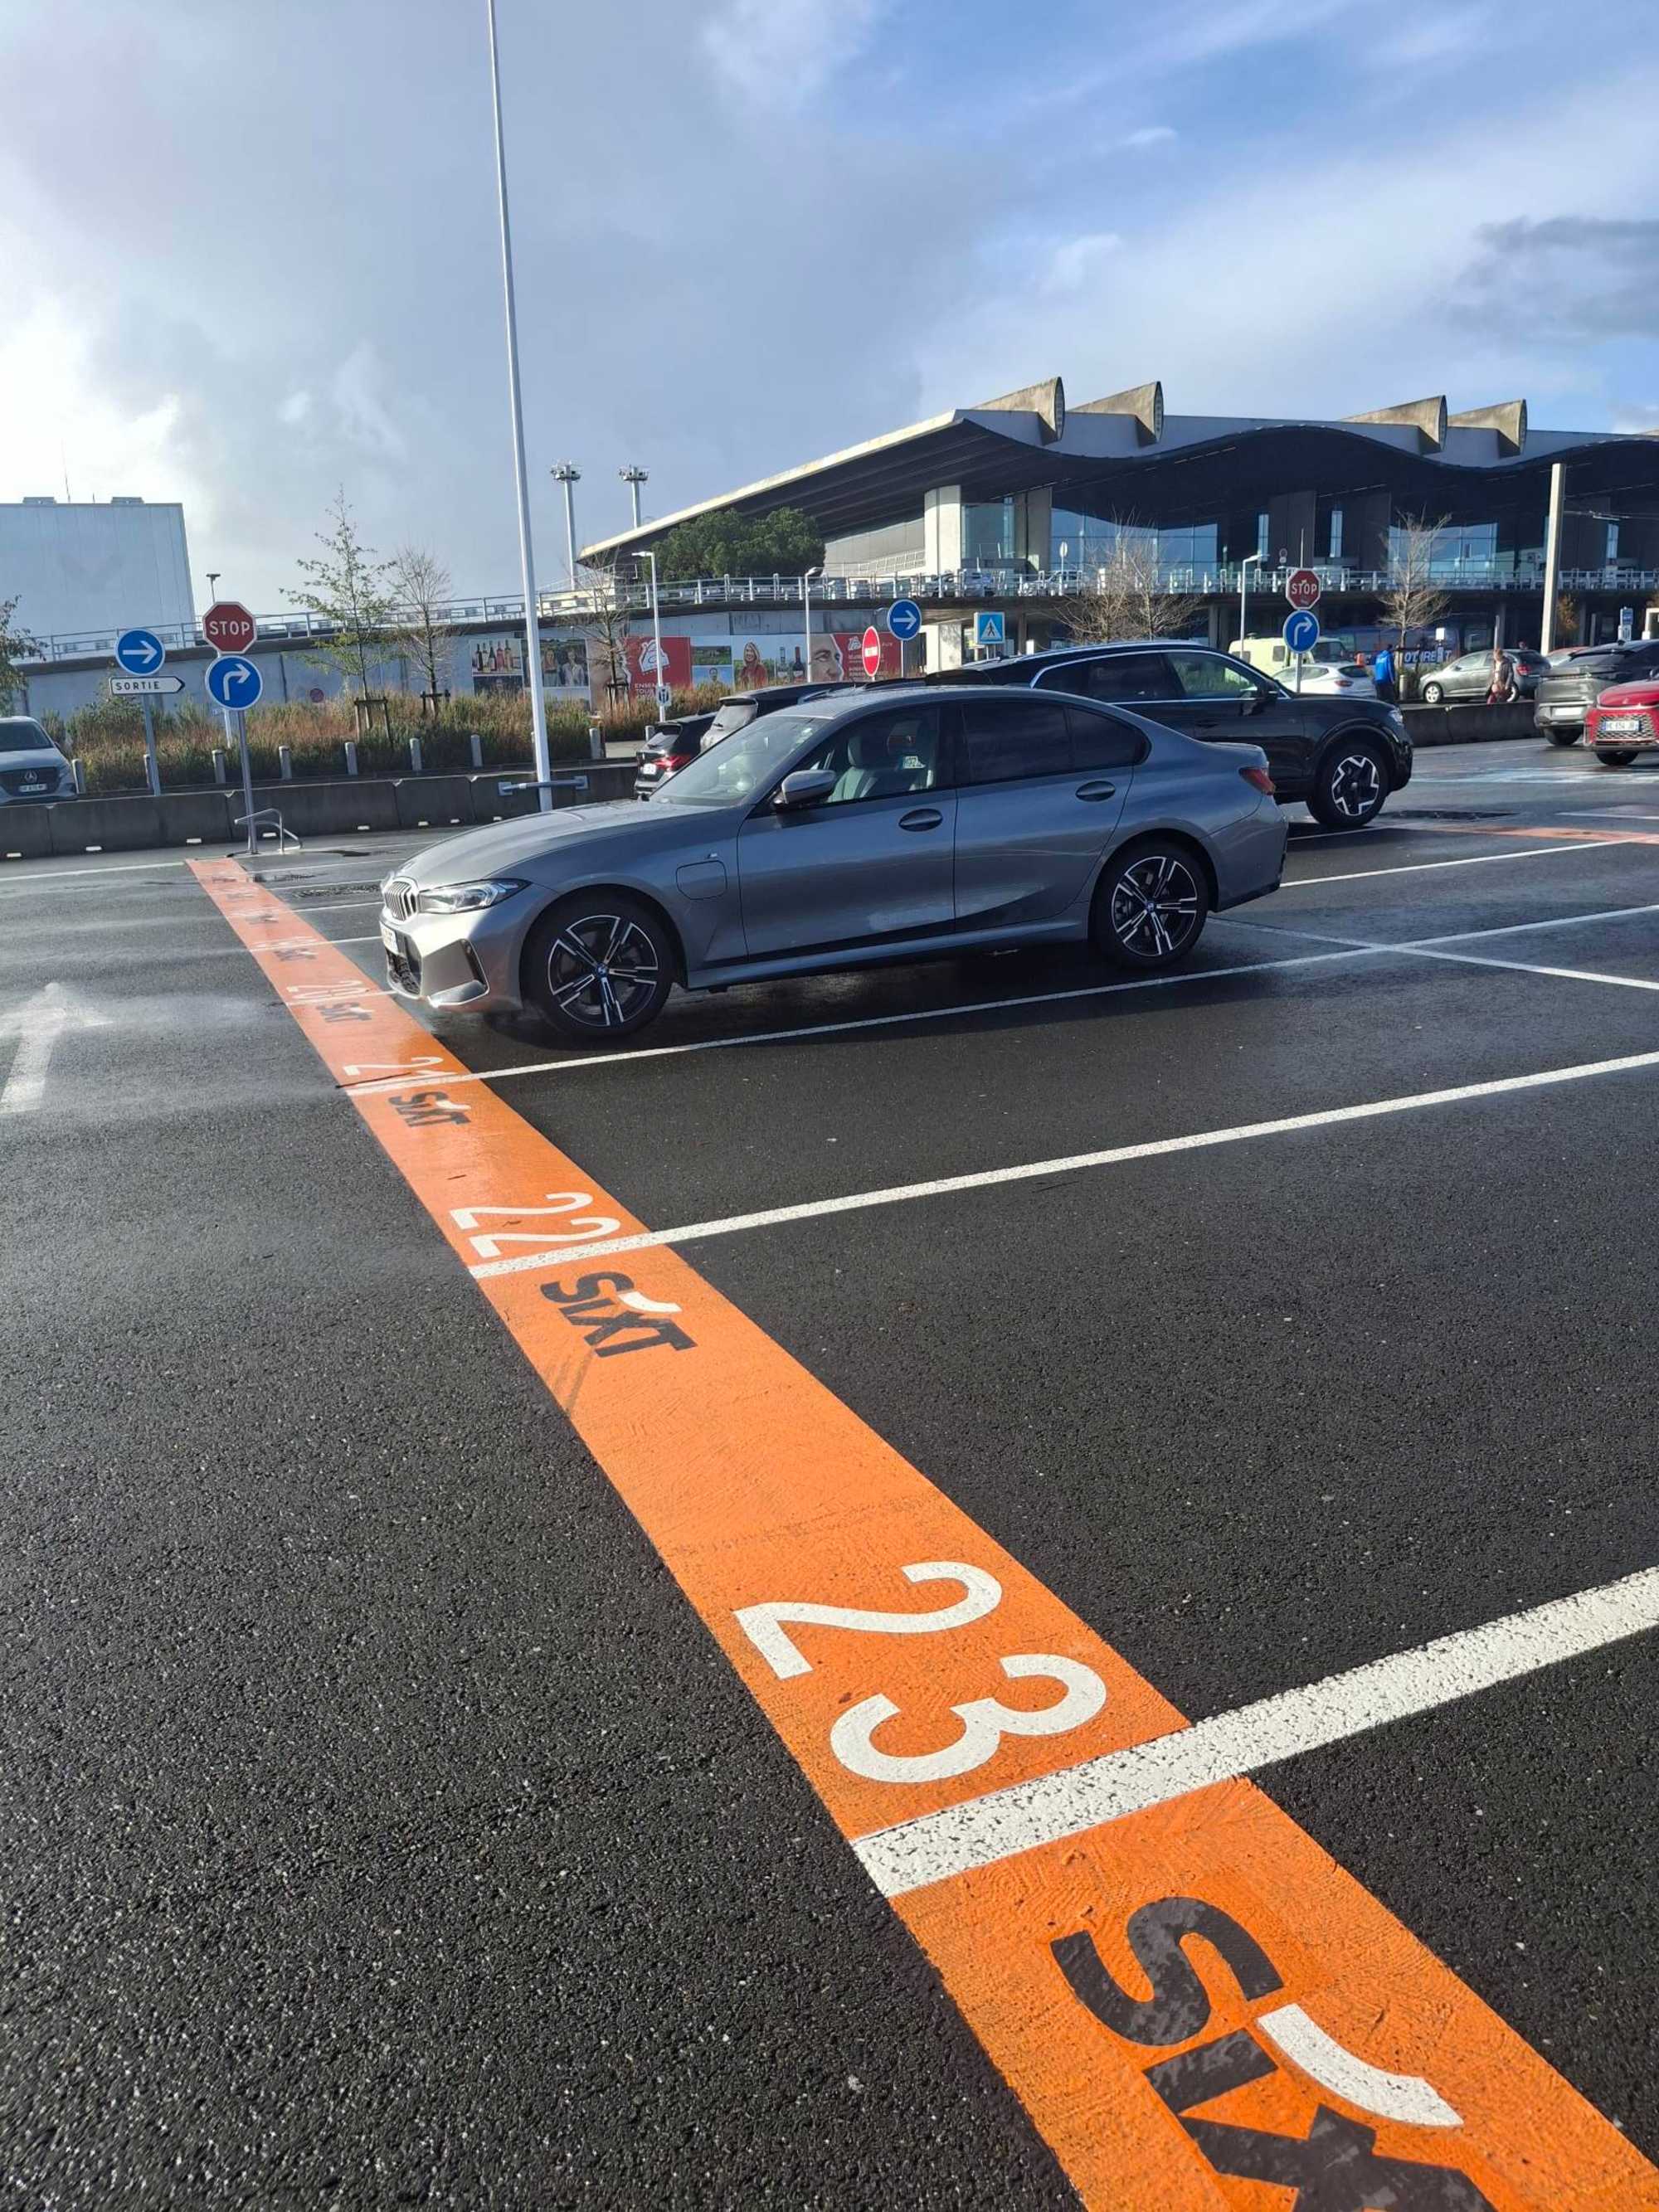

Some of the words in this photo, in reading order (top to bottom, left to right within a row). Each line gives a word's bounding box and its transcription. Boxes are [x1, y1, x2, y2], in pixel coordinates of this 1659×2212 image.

[1292, 583, 1317, 595] STOP
[209, 621, 251, 636] STOP
[115, 681, 160, 691] SORTIE
[388, 1091, 472, 1128] SIXT
[449, 1192, 620, 1258] 22
[540, 1271, 697, 1358] SIXT
[734, 1561, 1107, 1783] 23
[1050, 1897, 1500, 2212] SIX
